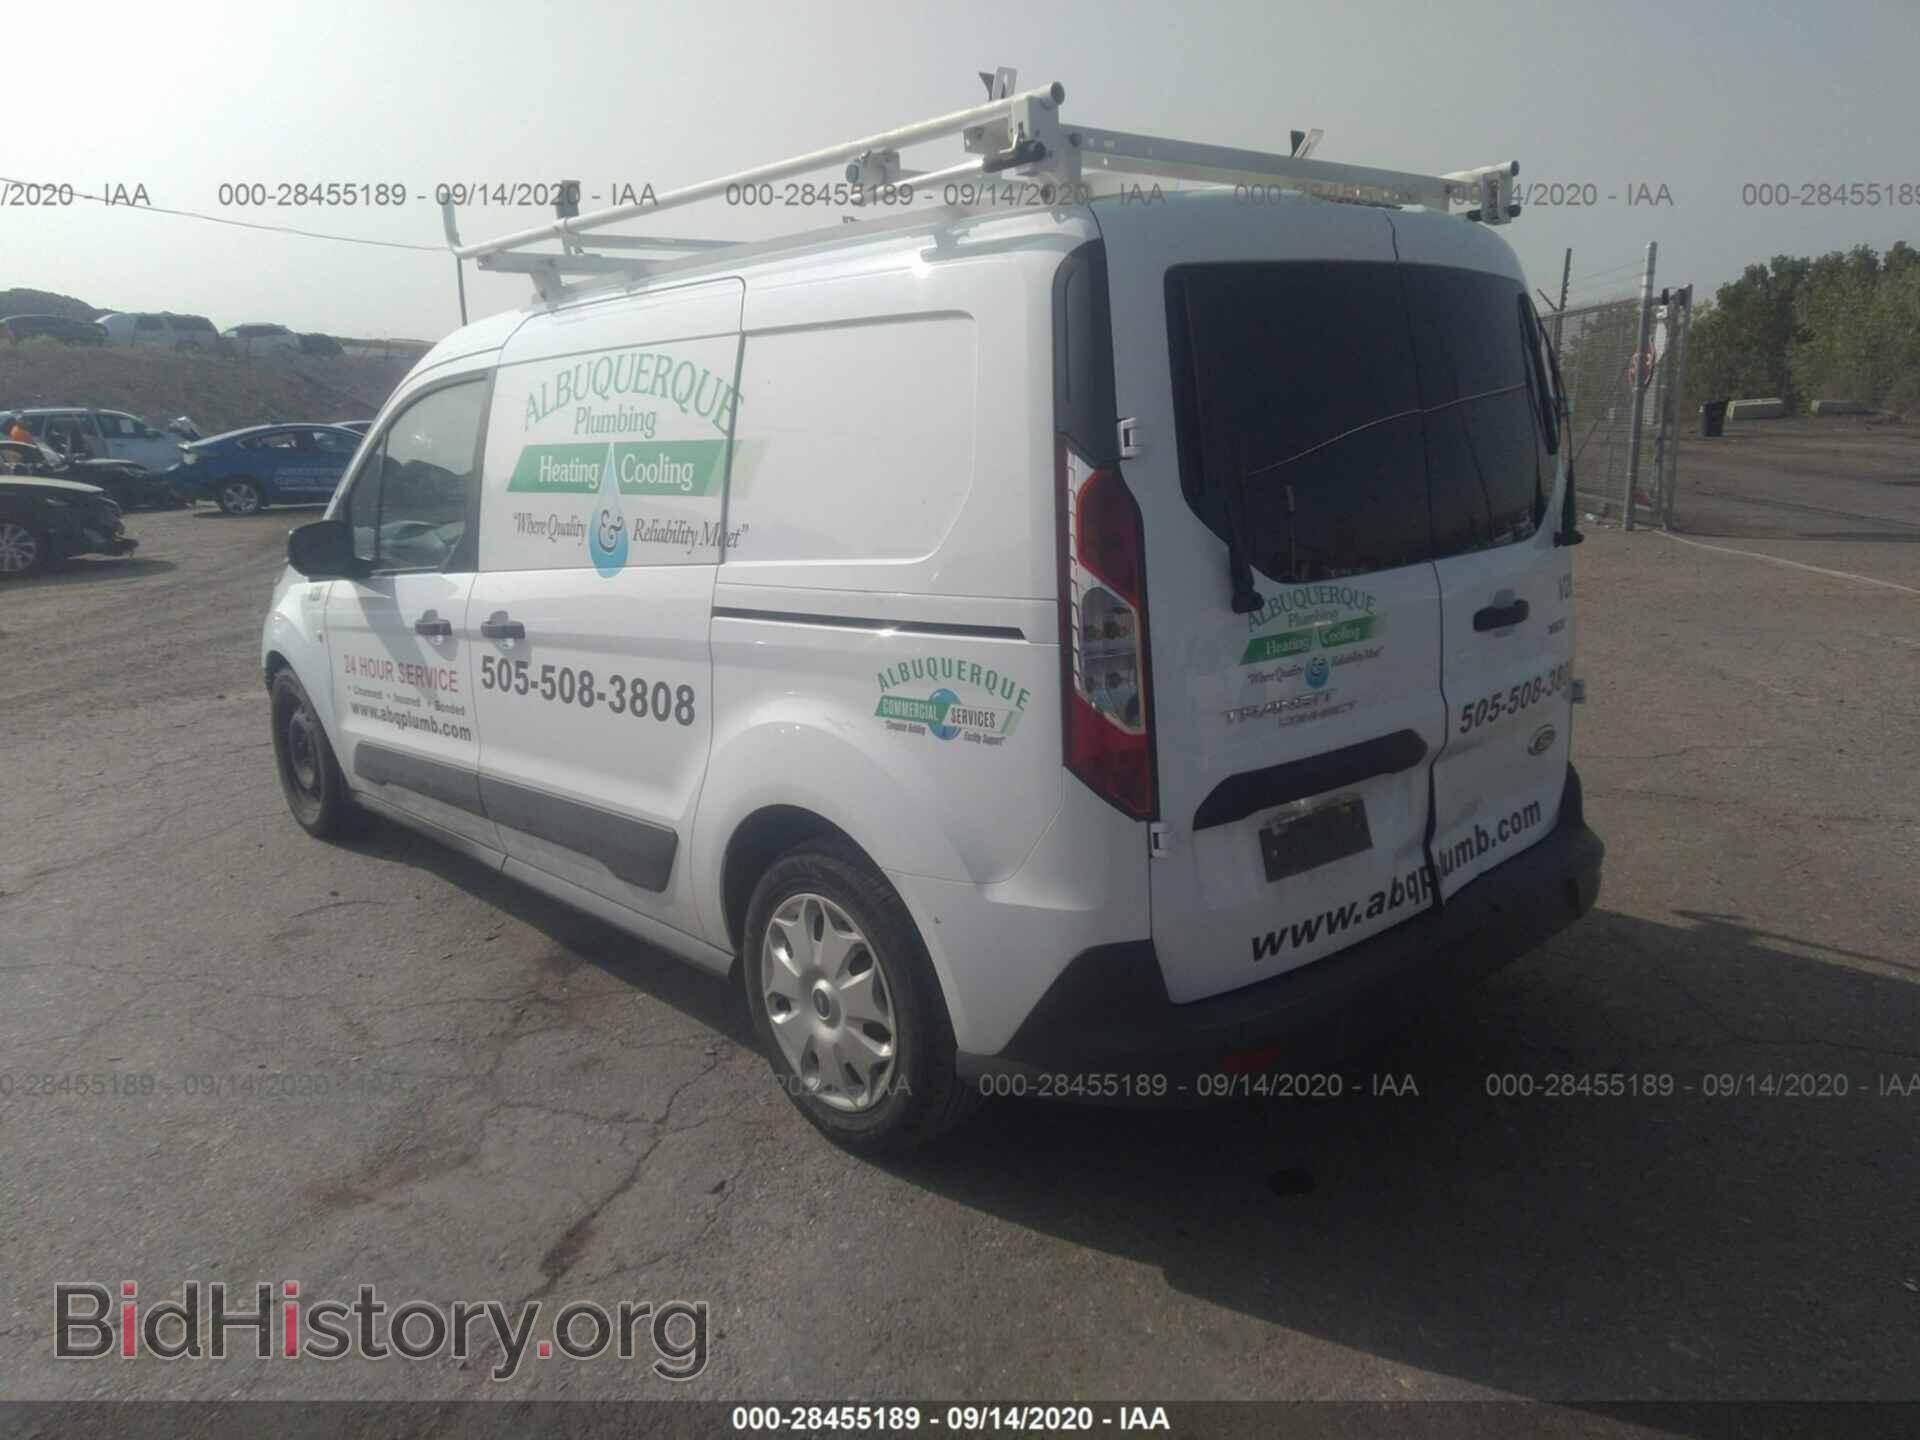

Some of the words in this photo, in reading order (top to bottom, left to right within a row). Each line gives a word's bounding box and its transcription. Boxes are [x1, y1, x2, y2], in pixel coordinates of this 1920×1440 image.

[524, 352, 745, 438] ALBUQUERQUE
[573, 404, 657, 440] Plumbing
[539, 455, 599, 490] Heating
[621, 452, 695, 492] Cooling
[547, 513, 588, 544] Quality
[598, 508, 625, 554] &
[632, 517, 700, 555] Reliability
[1248, 585, 1377, 634] ALBUQUERQUE
[359, 656, 395, 683] HOUR
[398, 662, 460, 694] SERVICE
[481, 655, 696, 727] 505-508-3808
[876, 656, 1032, 712] ALBUQUERQUE
[349, 701, 473, 742] www.abqplumb.com
[881, 698, 939, 722] COMMERCIAL
[950, 706, 997, 729] SERVICES
[1250, 800, 1542, 963] www.abqpumb.com
